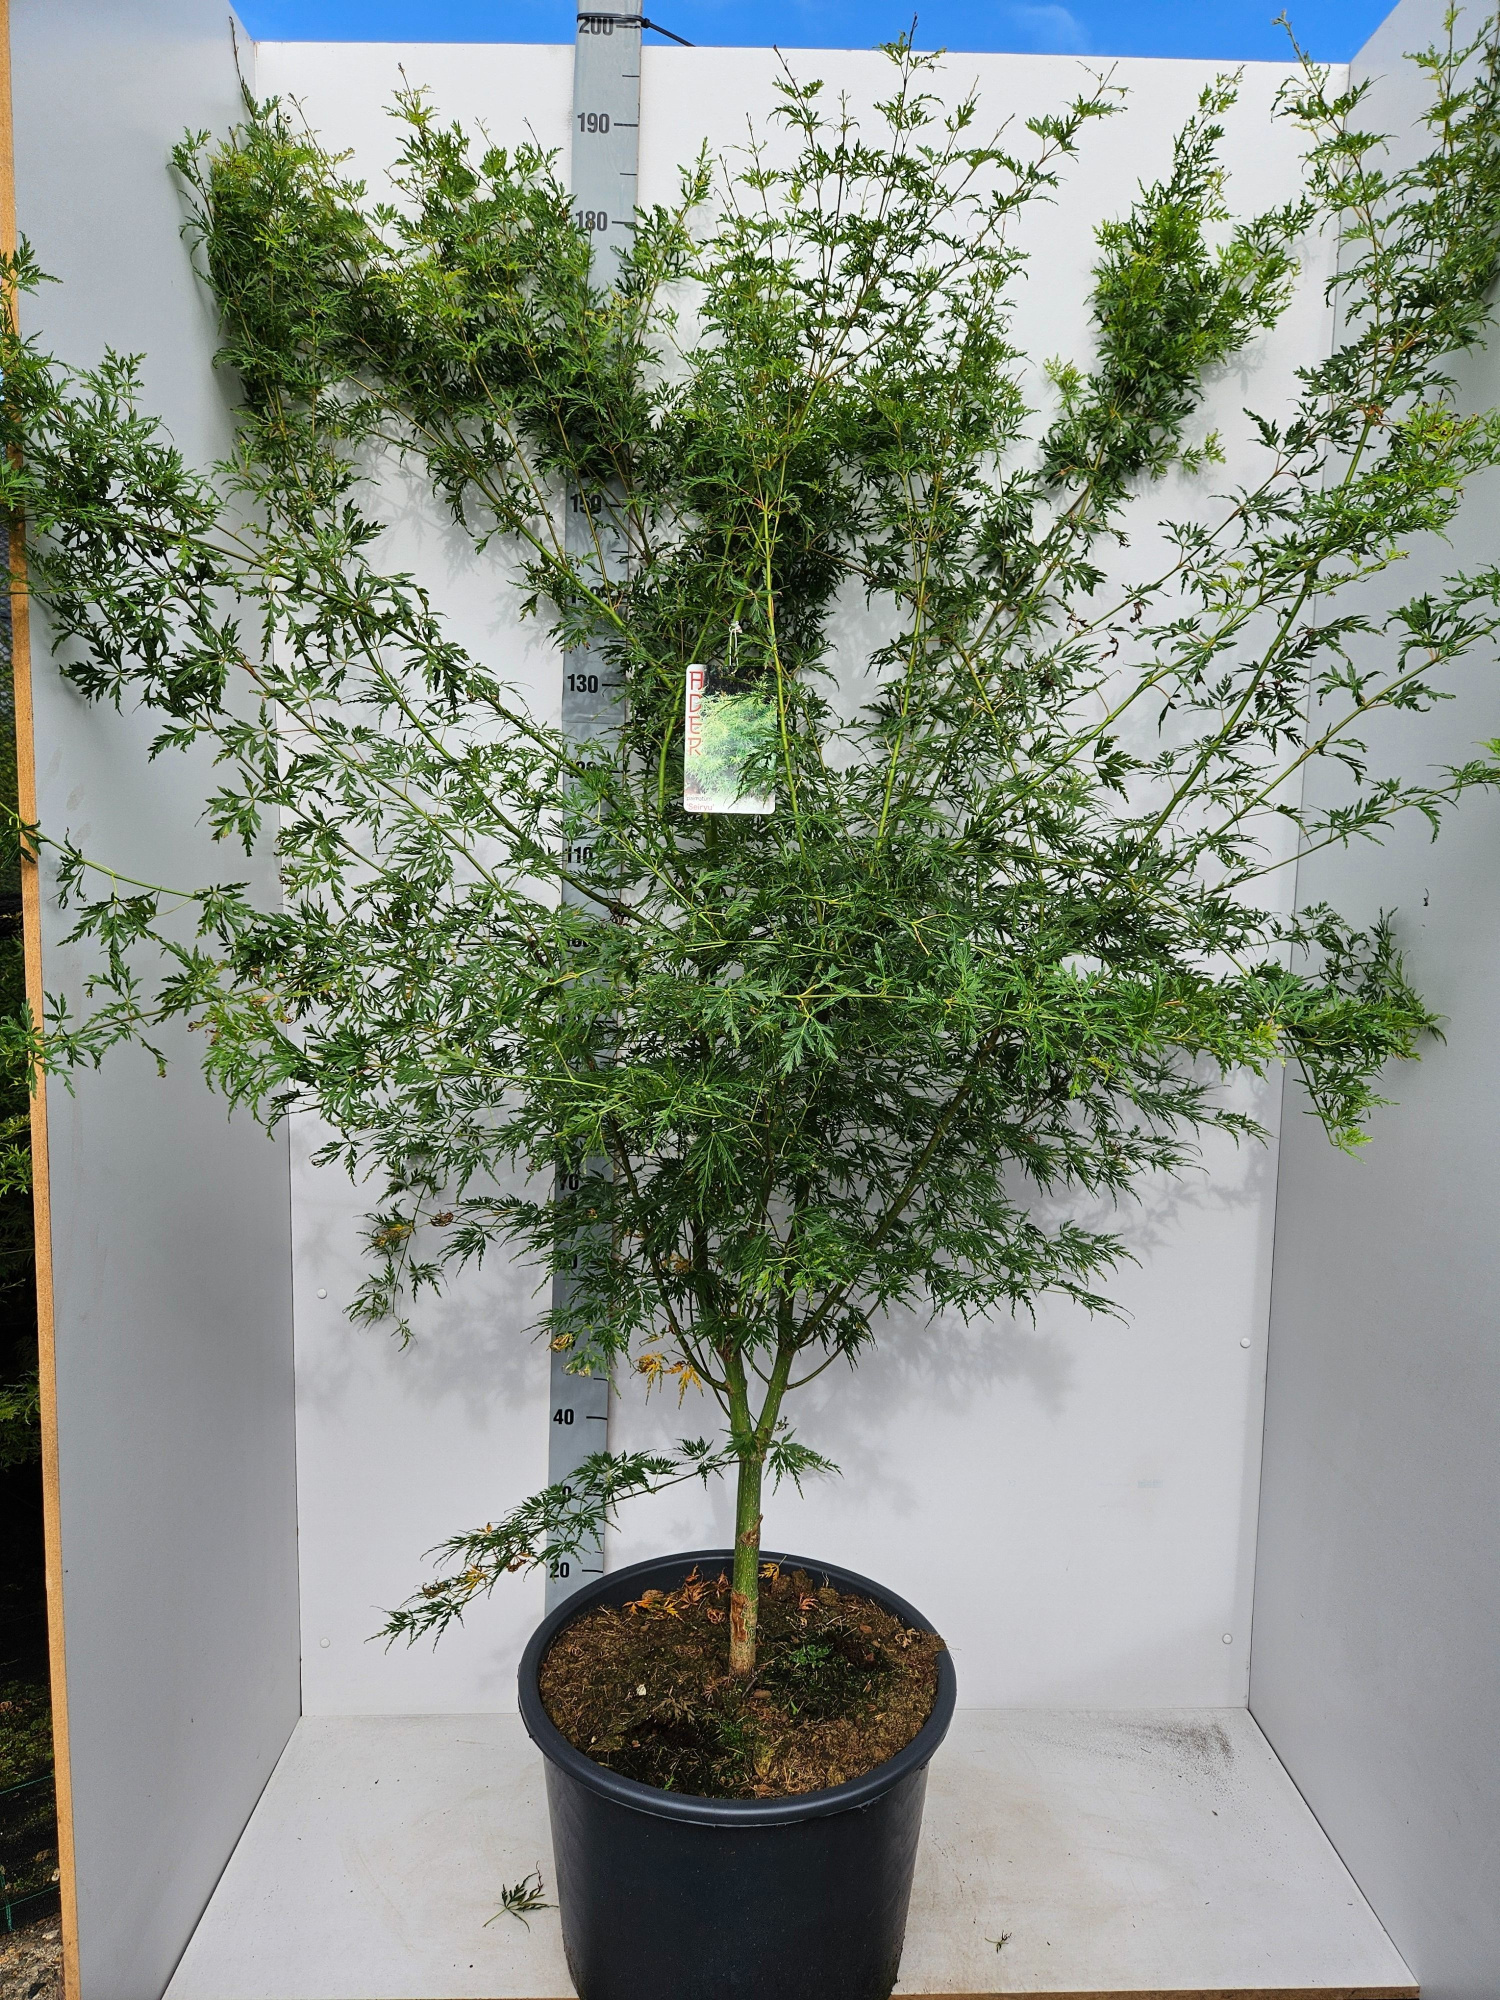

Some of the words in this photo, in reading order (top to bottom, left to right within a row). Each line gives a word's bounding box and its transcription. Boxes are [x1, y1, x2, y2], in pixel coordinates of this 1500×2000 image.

[579, 17, 613, 35] 200
[577, 112, 610, 134] 190
[575, 210, 608, 231] 180
[567, 673, 599, 693] 130
[553, 1408, 575, 1425] 40
[549, 1562, 570, 1578] 20
